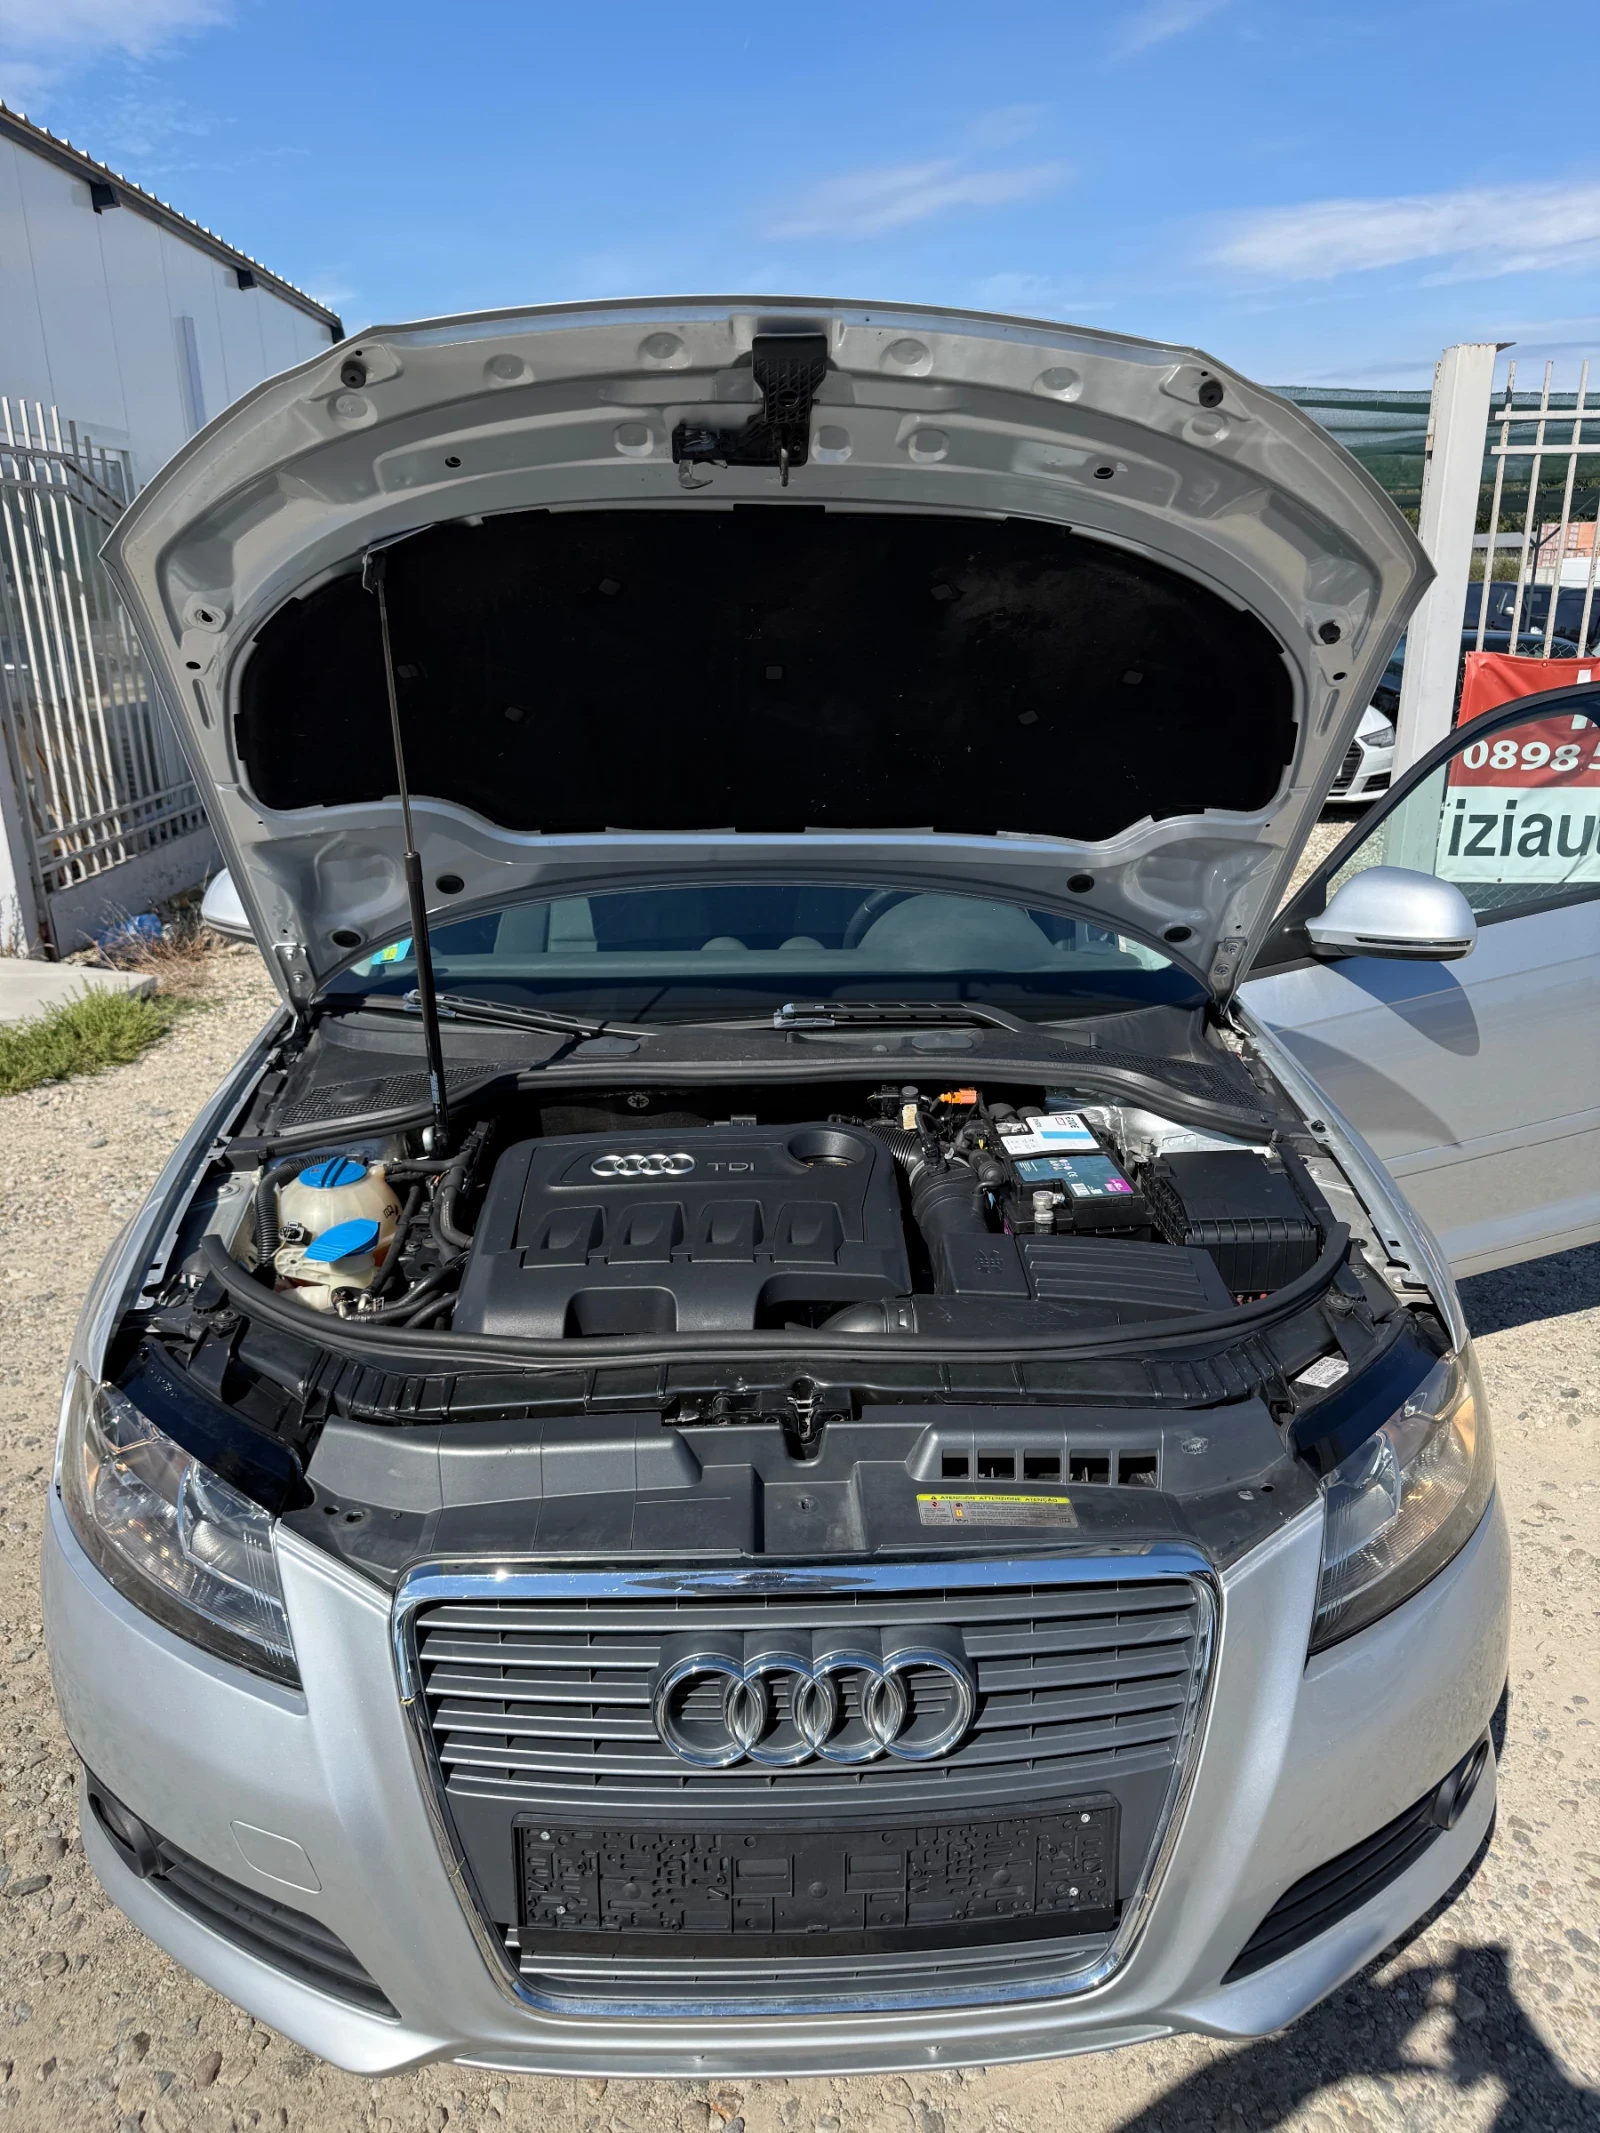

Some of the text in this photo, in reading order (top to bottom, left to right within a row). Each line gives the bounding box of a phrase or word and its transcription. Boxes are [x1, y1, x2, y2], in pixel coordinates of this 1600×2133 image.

[1463, 740, 1581, 771] 0898
[1448, 799, 1600, 858] iziau
[706, 1162, 754, 1171] TDI
